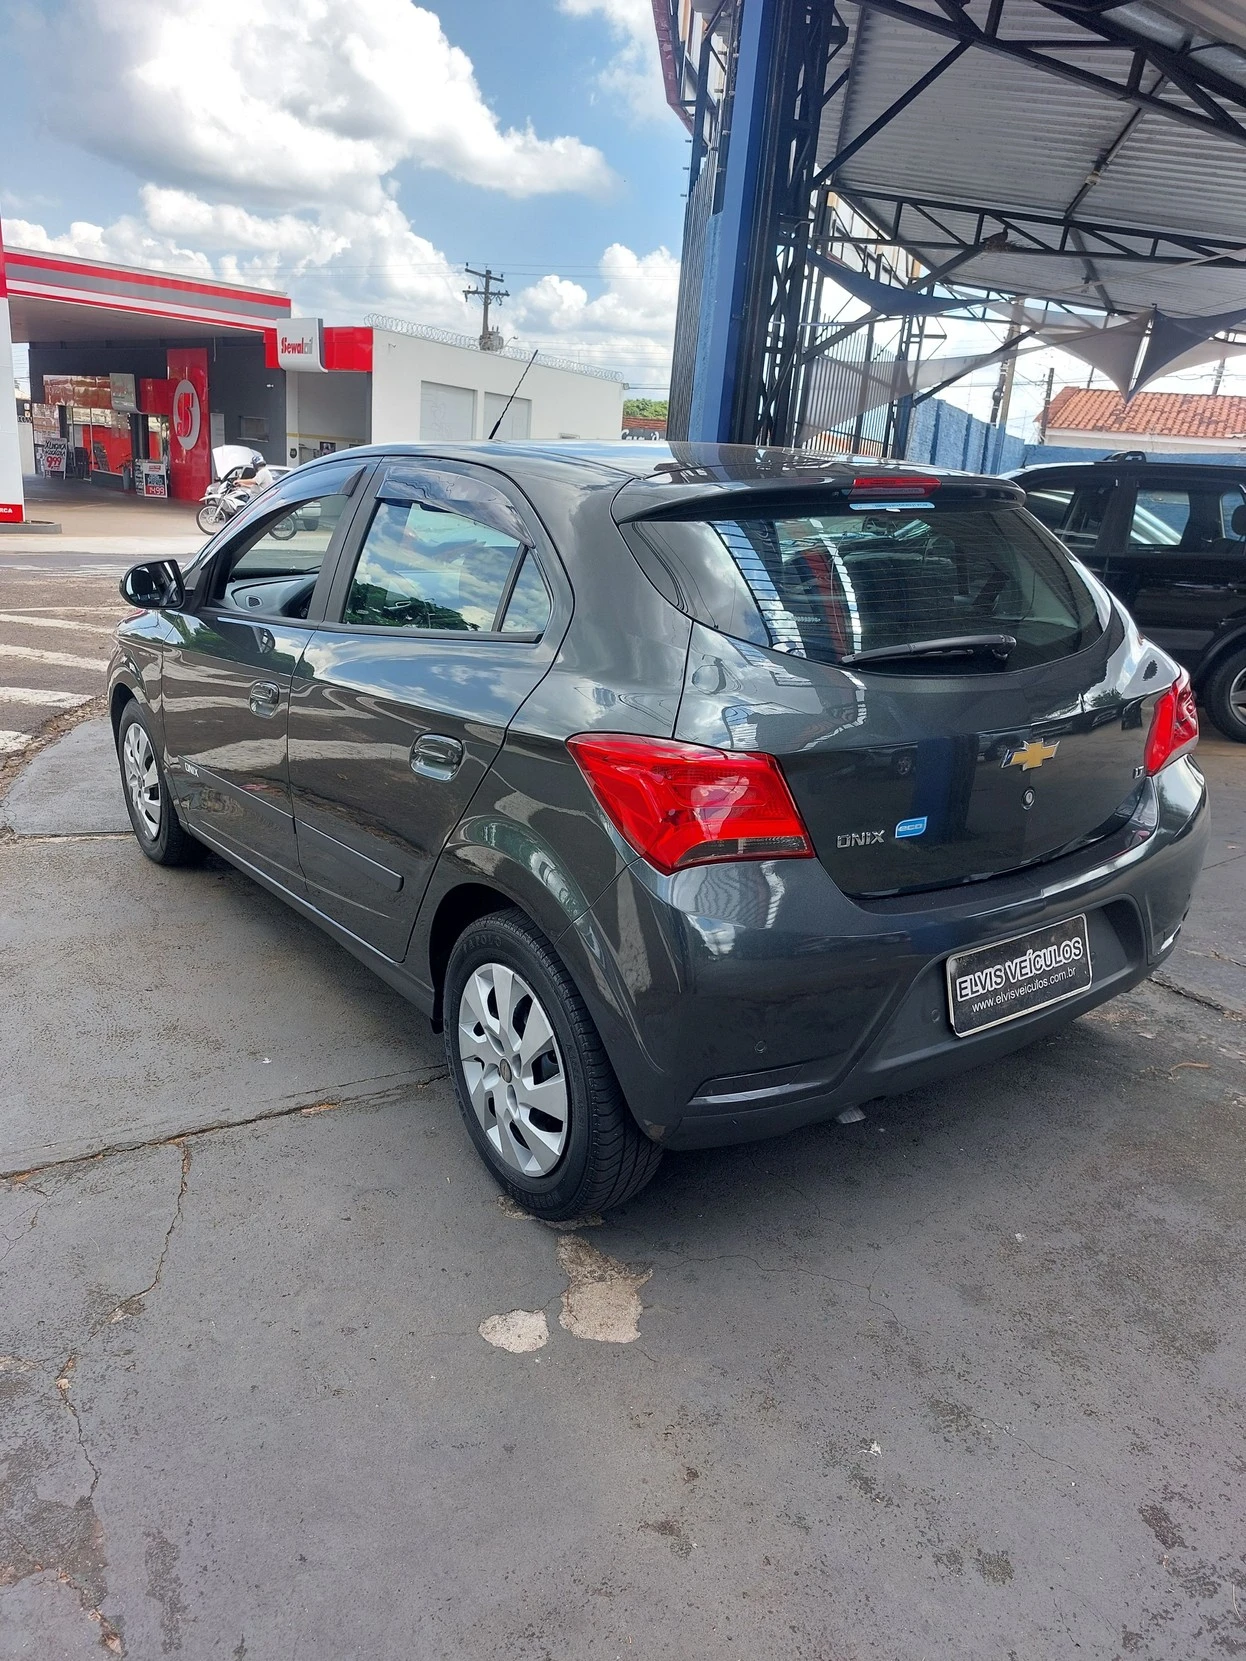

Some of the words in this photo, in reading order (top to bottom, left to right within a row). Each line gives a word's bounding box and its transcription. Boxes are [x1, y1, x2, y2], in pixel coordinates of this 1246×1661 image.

[837, 829, 886, 849] ONIX
[898, 823, 924, 832] eco
[956, 964, 1006, 1002] ELVIS
[1005, 936, 1084, 984] VEÍCULOS
[971, 965, 1077, 1013] www.elvisveiculos.com.br
